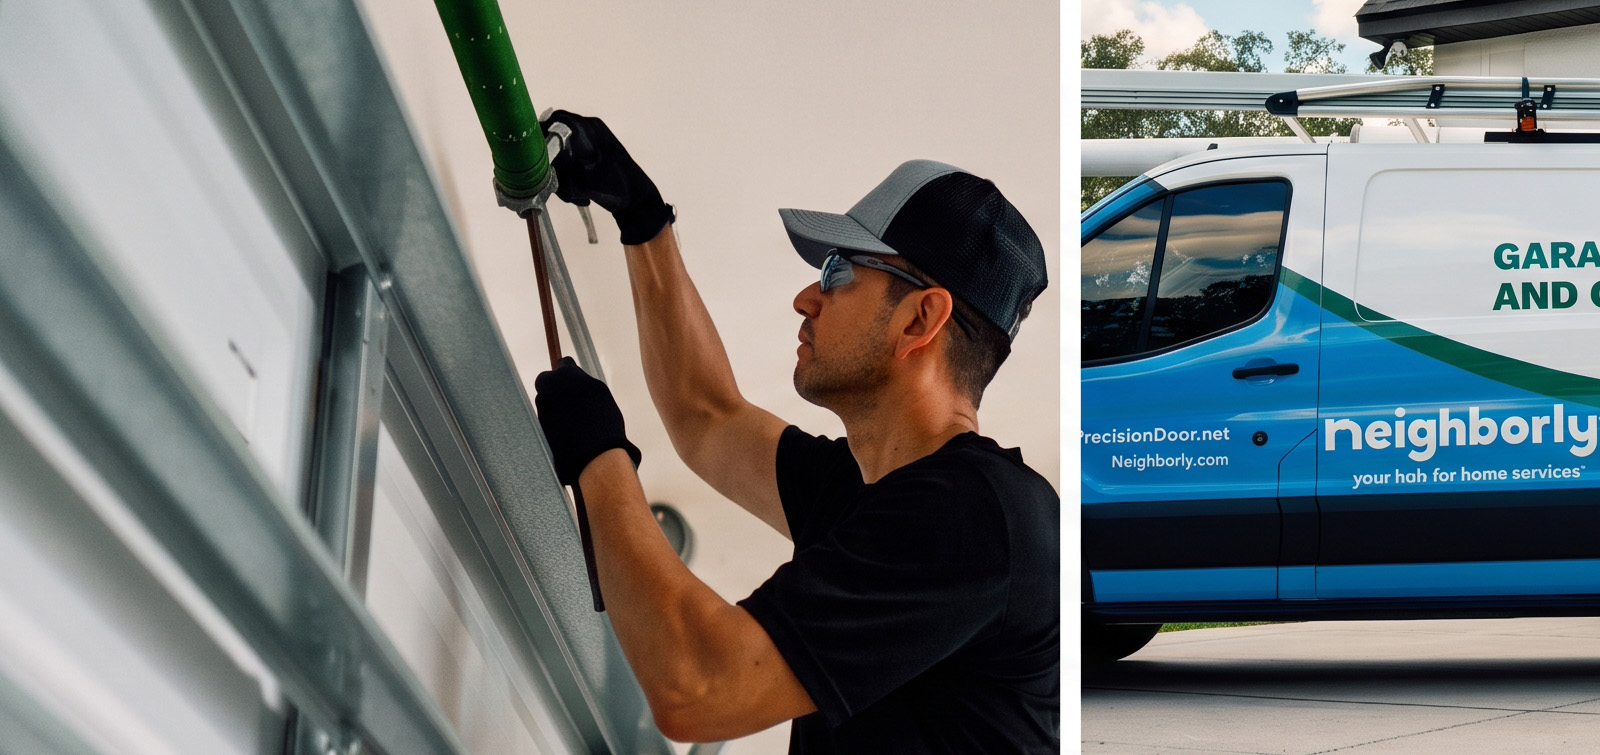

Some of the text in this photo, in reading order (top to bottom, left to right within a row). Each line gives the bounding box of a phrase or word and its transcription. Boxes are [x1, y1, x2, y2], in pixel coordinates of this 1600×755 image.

[1492, 281, 1579, 311] AND
[1325, 403, 1598, 462] neighborly
[1111, 453, 1229, 472] Neighborly.com
[1352, 471, 1391, 489] your
[1432, 466, 1457, 482] for
[1460, 466, 1508, 481] home
[1511, 463, 1581, 479] services
